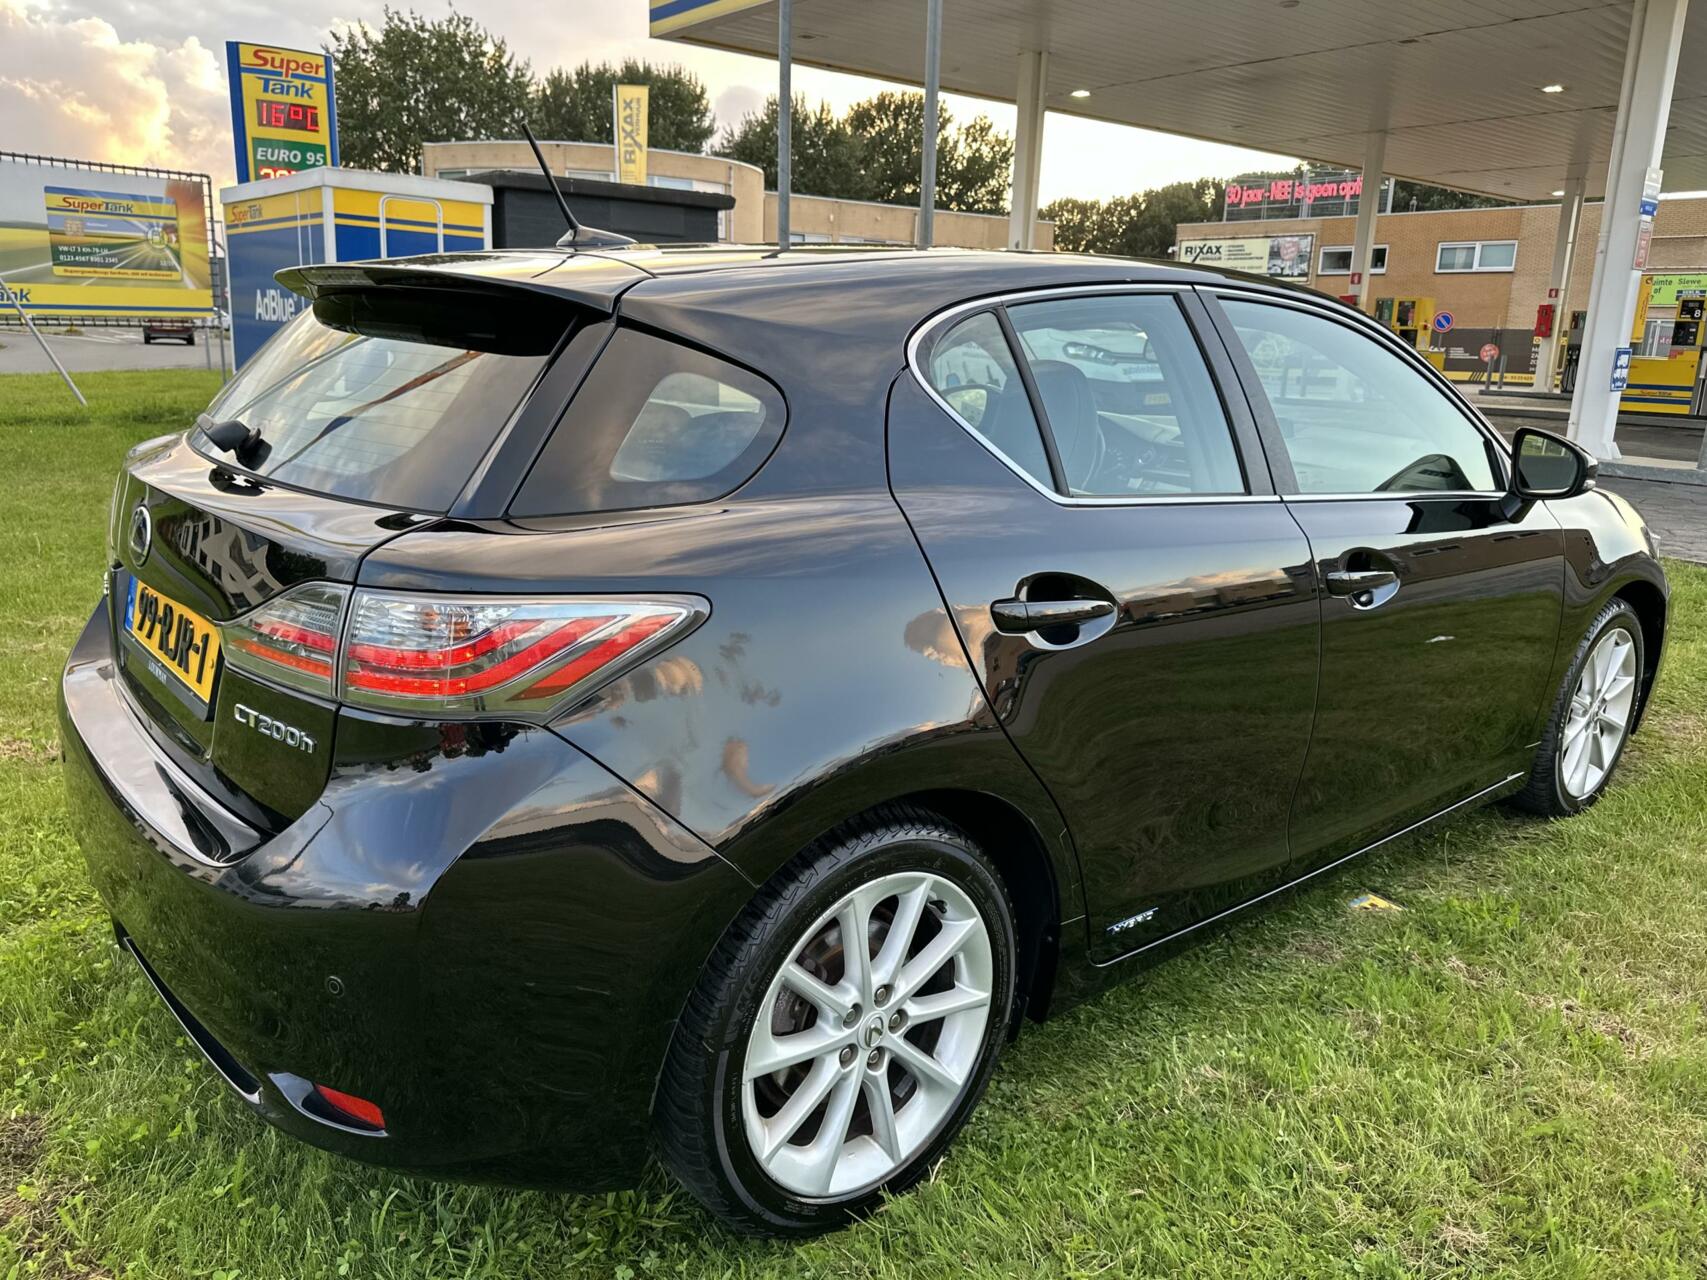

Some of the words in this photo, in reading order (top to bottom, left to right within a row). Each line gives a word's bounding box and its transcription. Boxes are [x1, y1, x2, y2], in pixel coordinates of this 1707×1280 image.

[241, 48, 324, 78] Super
[256, 76, 313, 99] Tank
[622, 97, 643, 165] RIXAX
[256, 146, 302, 163] EURO
[306, 151, 325, 166] 95
[1226, 184, 1241, 204] 30
[1240, 186, 1264, 209] jaar
[1269, 180, 1292, 201] NEE
[1294, 180, 1304, 199] is
[1304, 182, 1337, 204] geen
[1339, 176, 1363, 202] opti
[58, 196, 134, 214] SuperTank
[1184, 243, 1223, 263] RIXAX
[0, 287, 31, 302] ank
[1694, 309, 1701, 318] 8
[138, 585, 210, 685] 99-RJR-1
